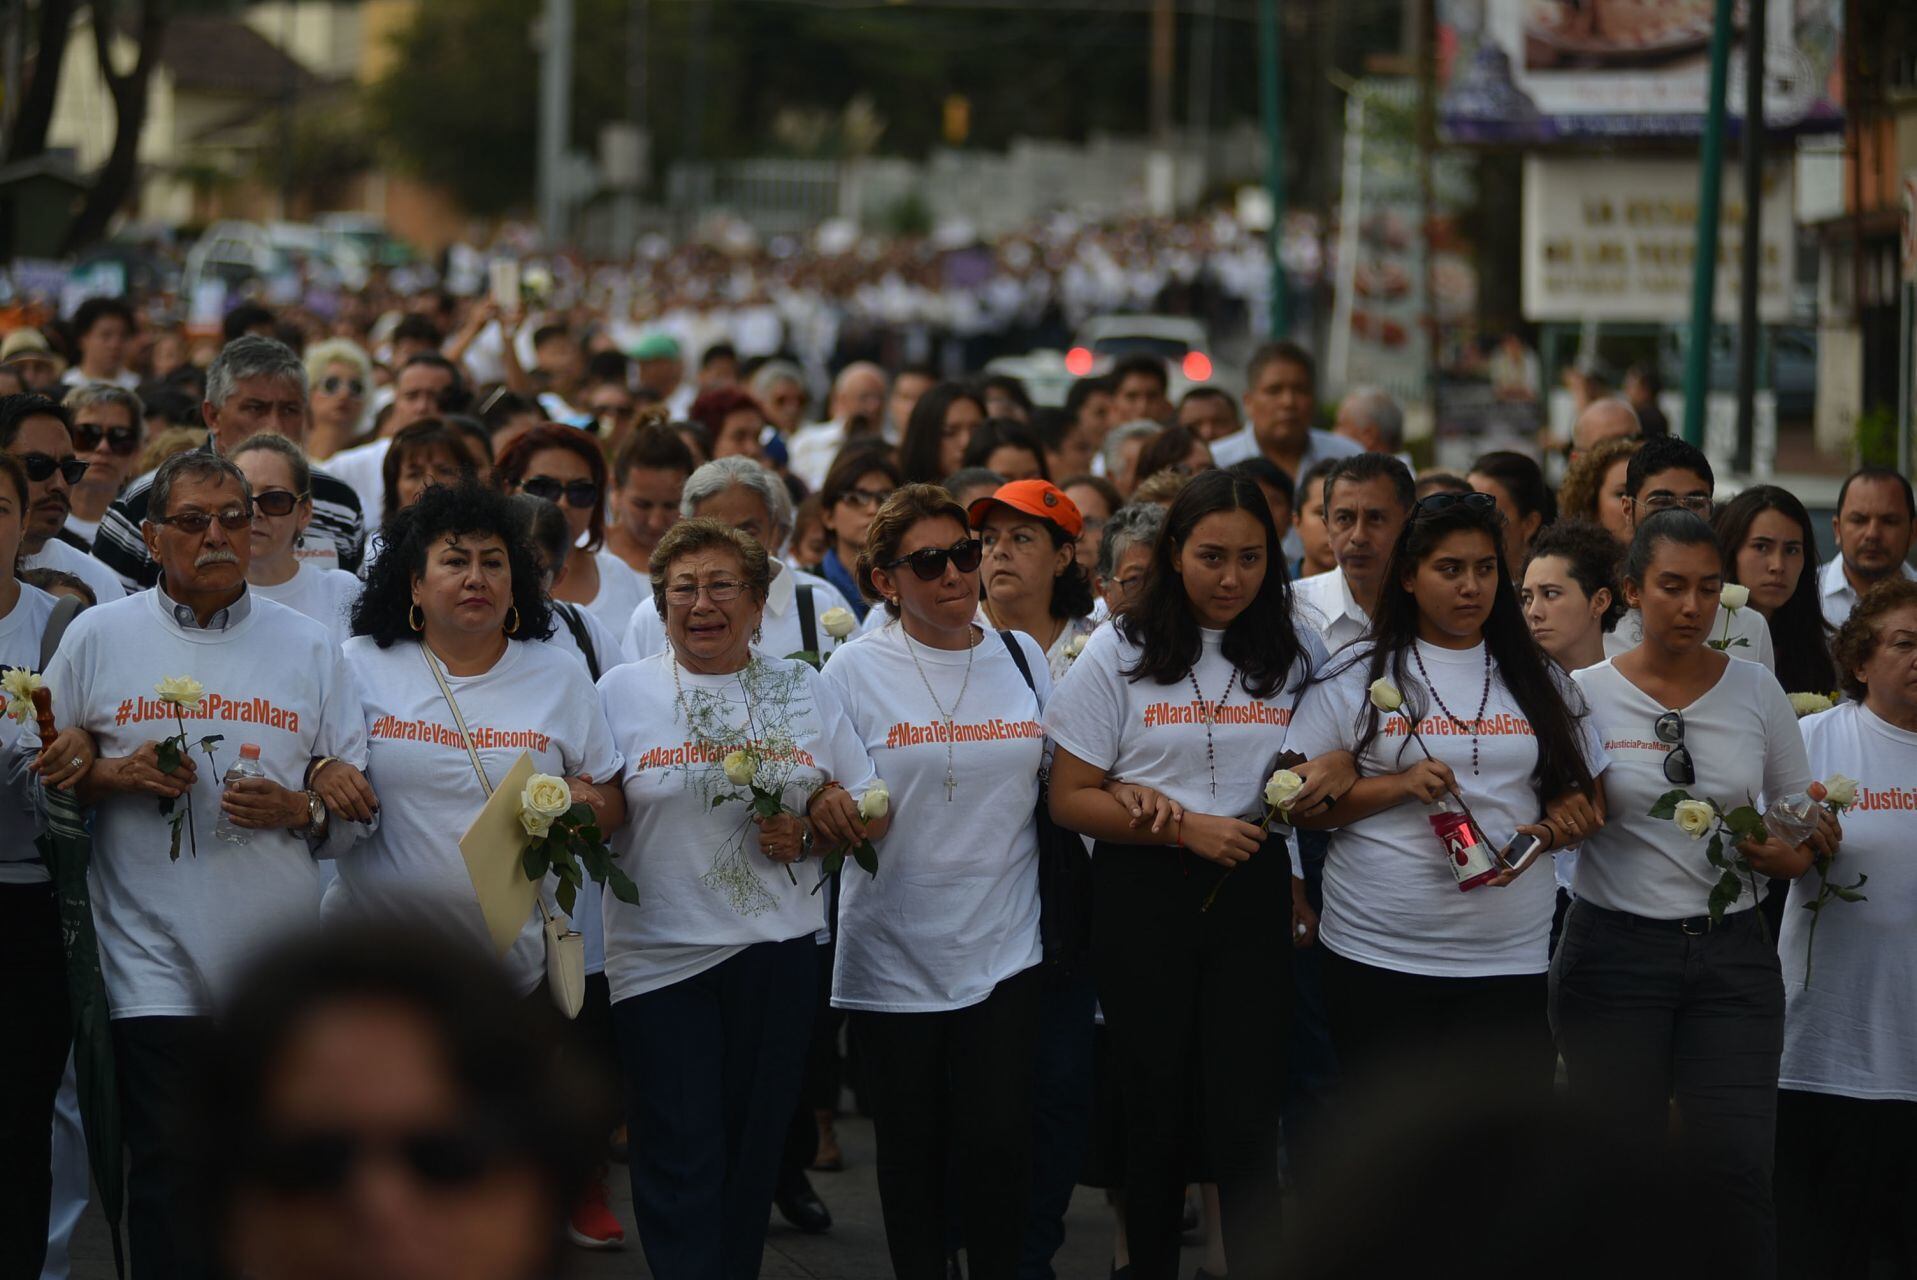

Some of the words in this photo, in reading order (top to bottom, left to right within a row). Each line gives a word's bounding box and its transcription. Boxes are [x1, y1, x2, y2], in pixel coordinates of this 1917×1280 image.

[371, 715, 551, 753] #MaraTeVamosAEncontrar
[1605, 739, 1671, 752] #JusticiaParaMara
[638, 739, 816, 770] #MaraTeVamAEntrar
[1845, 787, 1917, 812] Justici
